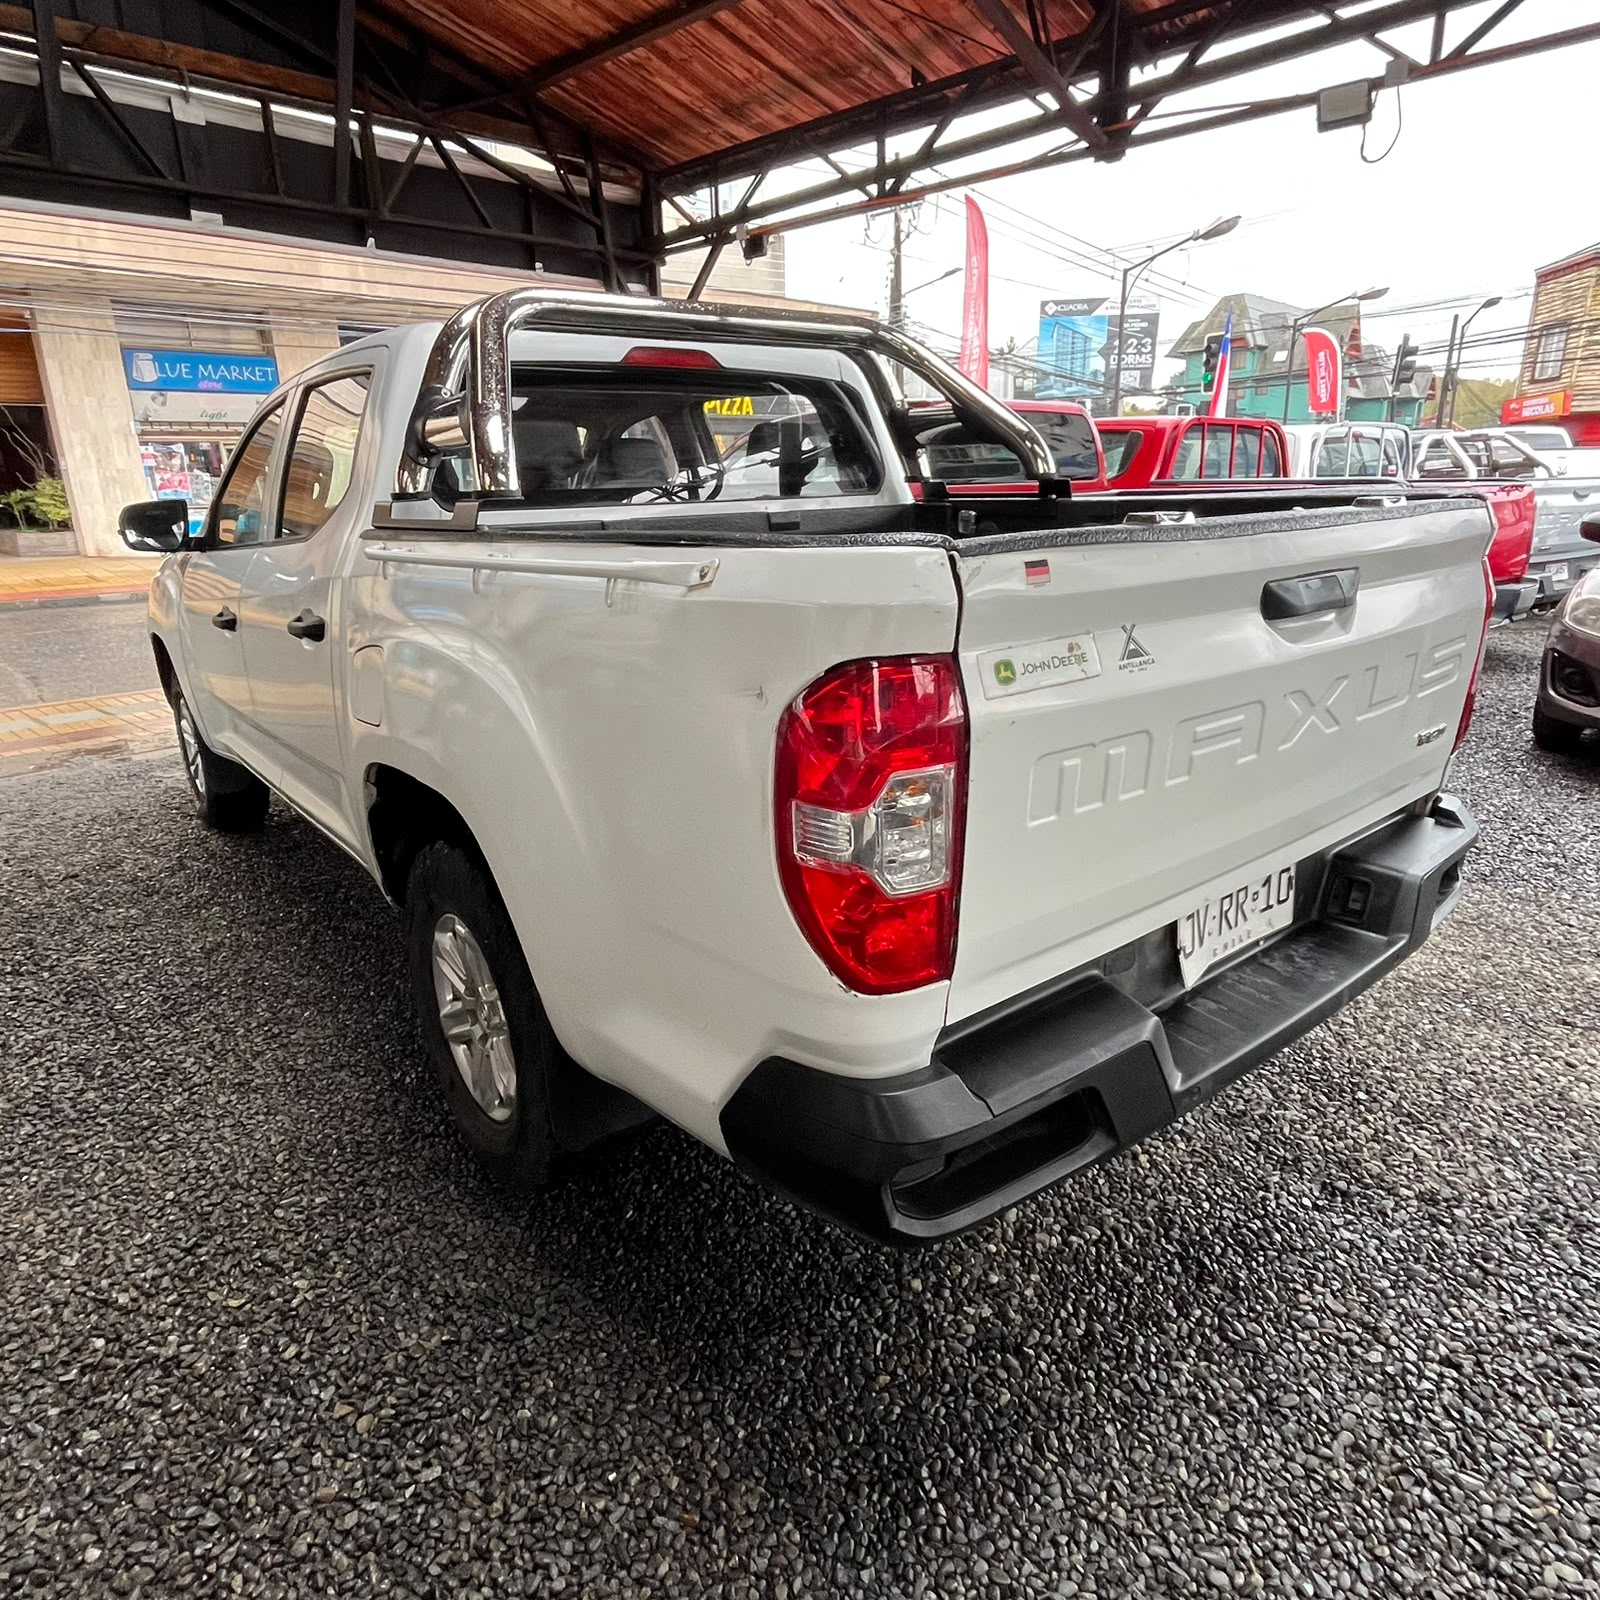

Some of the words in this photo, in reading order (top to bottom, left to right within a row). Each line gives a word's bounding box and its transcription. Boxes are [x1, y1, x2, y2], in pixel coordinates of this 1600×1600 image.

[198, 364, 275, 381] MARKET
[703, 396, 754, 416] PIZZA
[1020, 659, 1051, 676] JOHN
[1051, 652, 1088, 669] DEERE
[1118, 658, 1156, 671] ANTILLANCA
[1028, 636, 1466, 827] MAXUS
